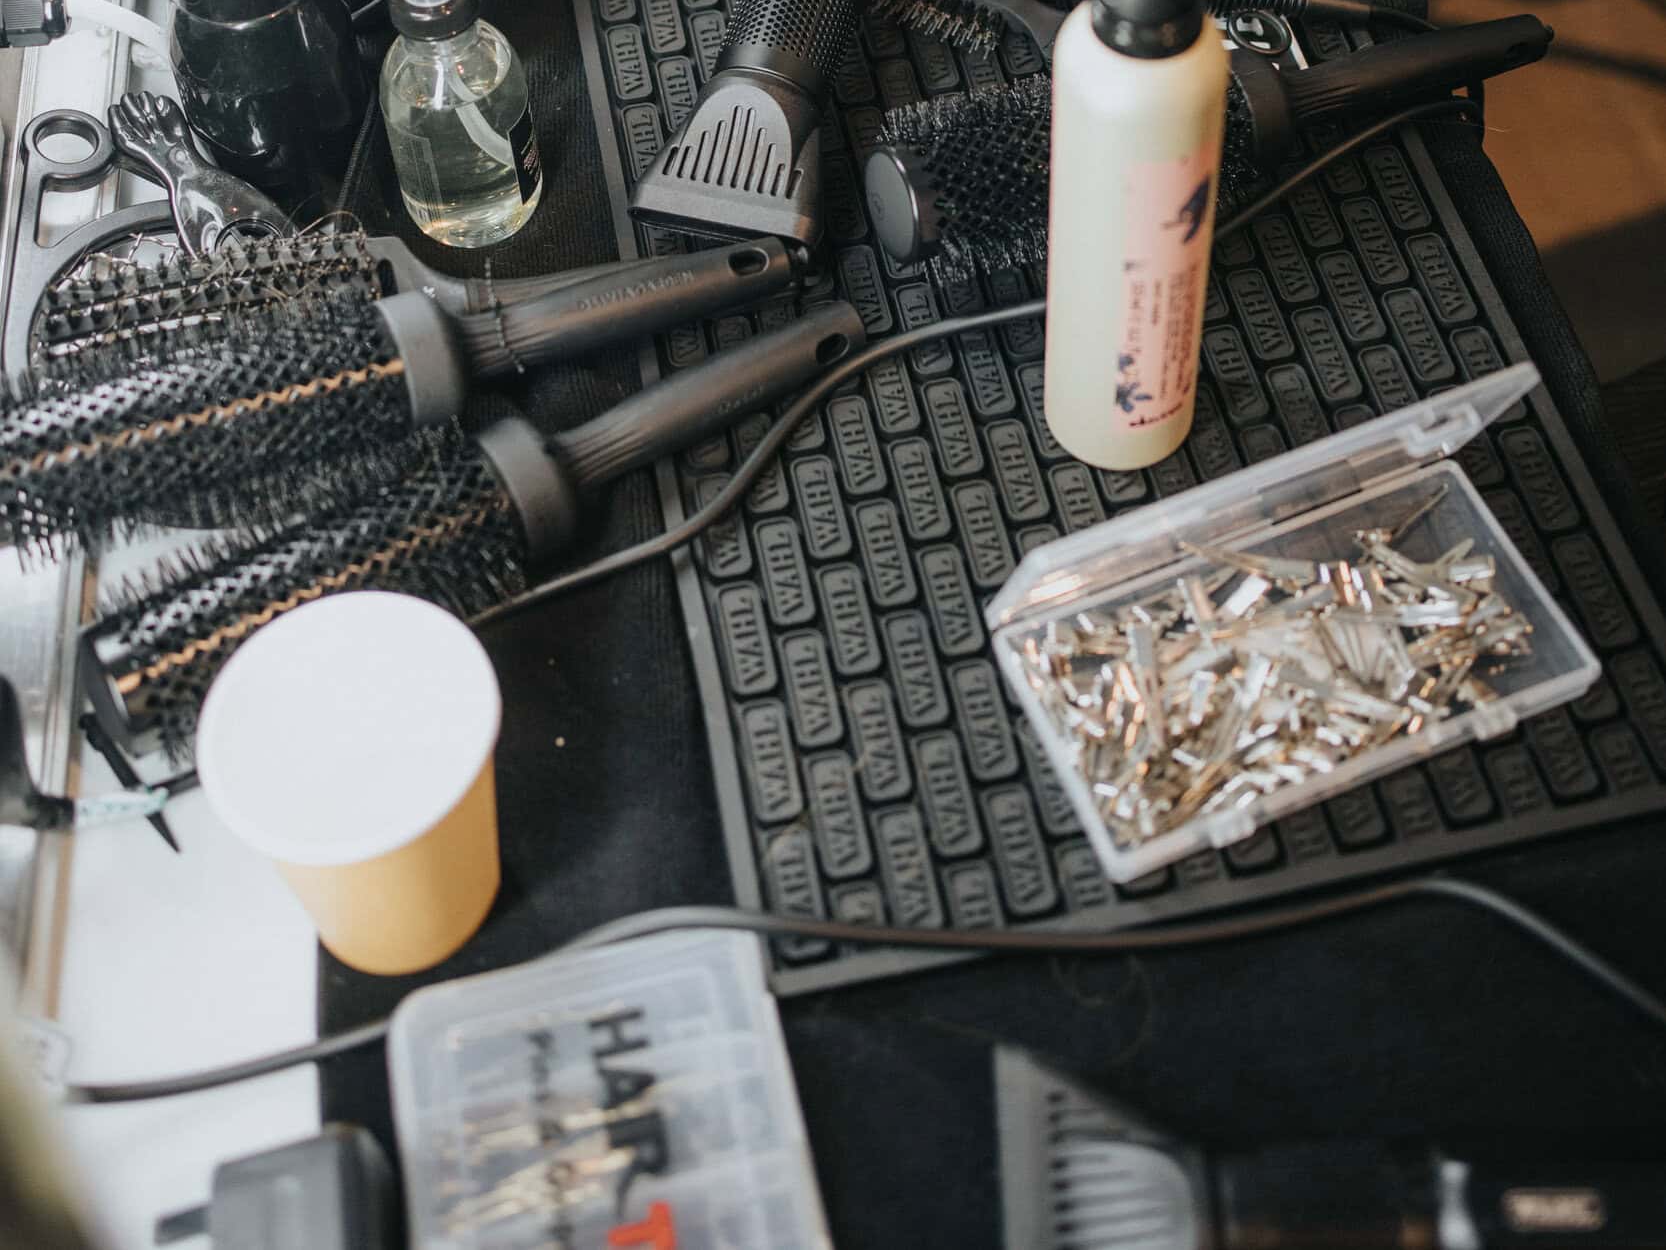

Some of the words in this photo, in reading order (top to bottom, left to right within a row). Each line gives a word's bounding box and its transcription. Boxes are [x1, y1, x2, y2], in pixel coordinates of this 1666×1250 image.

[614, 33, 644, 94] WAHL
[1374, 156, 1418, 226] WAHL
[1263, 225, 1310, 293] WAHL
[1353, 207, 1398, 279] WAHL
[1421, 245, 1465, 315] WAHL
[850, 261, 884, 329] WAHL
[1239, 280, 1285, 351] WAHL
[1329, 260, 1375, 335] WAHL
[961, 331, 1006, 408] WAHL
[1212, 337, 1255, 413] WAHL
[1305, 316, 1349, 395] WAHL
[1396, 299, 1441, 375] WAHL
[876, 362, 911, 426] WAH
[935, 392, 974, 468] WAHL
[839, 410, 877, 488] WAHL
[999, 433, 1038, 517] WAHL
[804, 470, 842, 551] WAHL
[902, 451, 940, 531] WAHL
[769, 532, 805, 618] WAHL
[867, 513, 906, 598] WAHL
[966, 494, 1007, 579] WAHL
[729, 596, 767, 687] WAHL
[829, 579, 870, 667] WAHL
[933, 559, 972, 647] WAHL
[793, 646, 831, 737] WAHL
[899, 626, 938, 719] WAHL
[753, 717, 791, 811] WAHL
[858, 701, 899, 791] WAHL
[962, 676, 1006, 775] WAHL
[818, 768, 860, 871] WAHL
[927, 753, 970, 844] WAHL
[1000, 802, 1045, 902] WAHL
